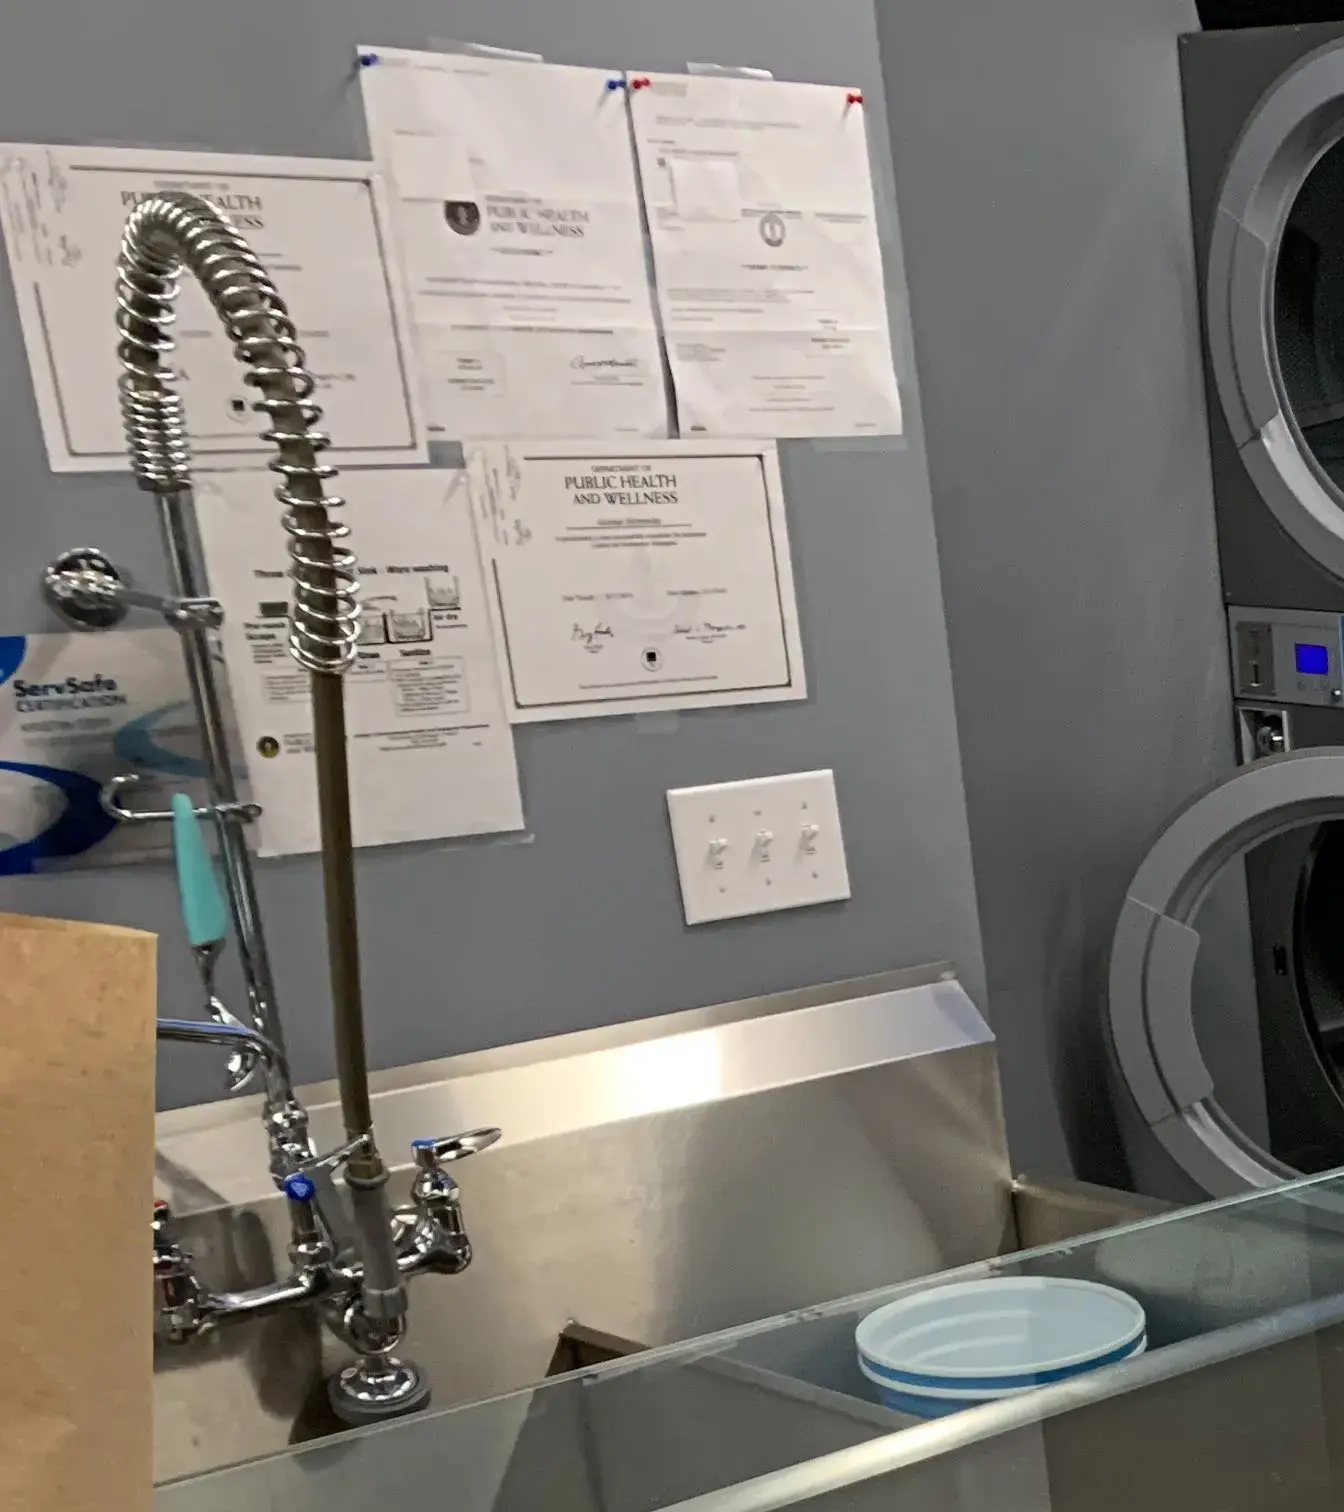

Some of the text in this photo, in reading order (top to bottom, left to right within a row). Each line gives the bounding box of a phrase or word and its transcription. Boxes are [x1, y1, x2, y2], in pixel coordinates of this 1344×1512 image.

[564, 475, 677, 490] PUBLIC HEALTH
[572, 491, 679, 505] AND WELLNESS
[12, 674, 118, 698] ServSafe
